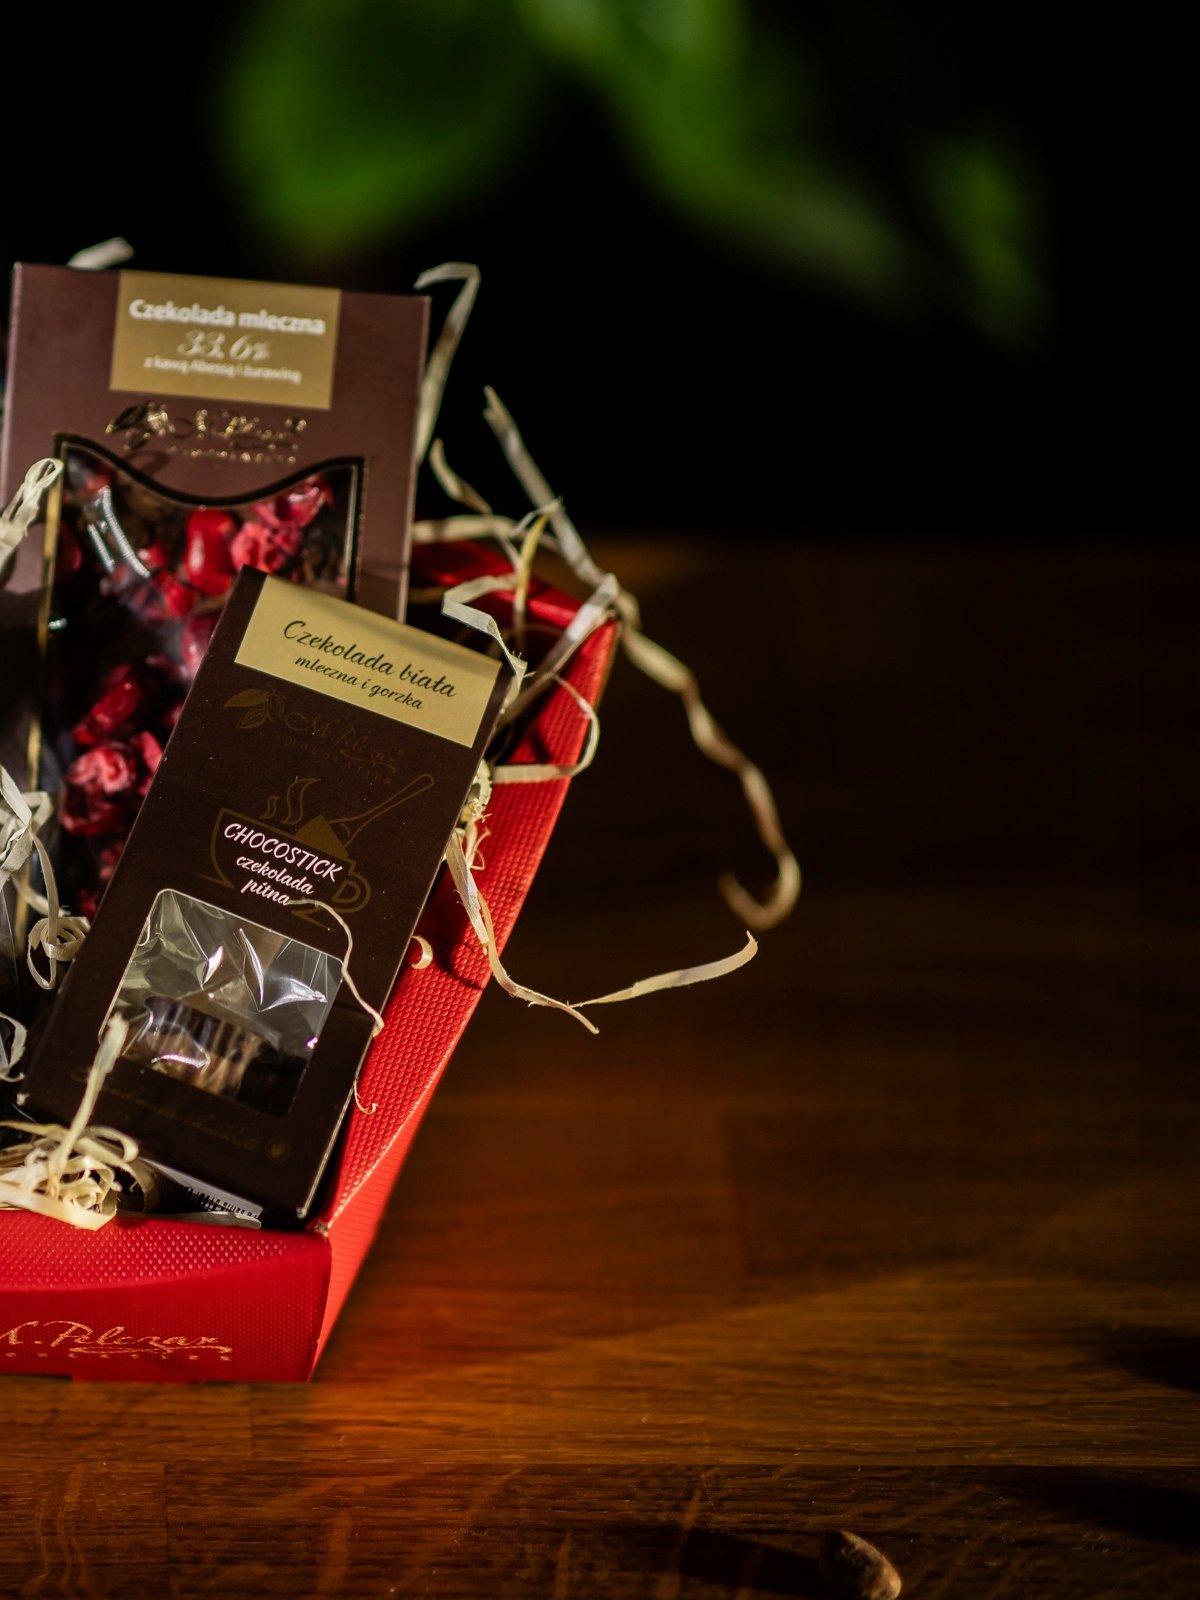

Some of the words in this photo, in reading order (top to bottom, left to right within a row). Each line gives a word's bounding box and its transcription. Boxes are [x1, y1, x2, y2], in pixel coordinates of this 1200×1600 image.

[129, 298, 236, 327] Czekolada
[237, 309, 326, 336] mleczna
[283, 619, 396, 676] Czekolada
[399, 663, 457, 698] biała
[294, 656, 359, 686] mleczna
[360, 678, 371, 690] i
[368, 684, 425, 710] gorzka
[224, 822, 344, 883] CHOCOSTICK
[236, 855, 315, 896] czekolada
[240, 879, 291, 907] pitna
